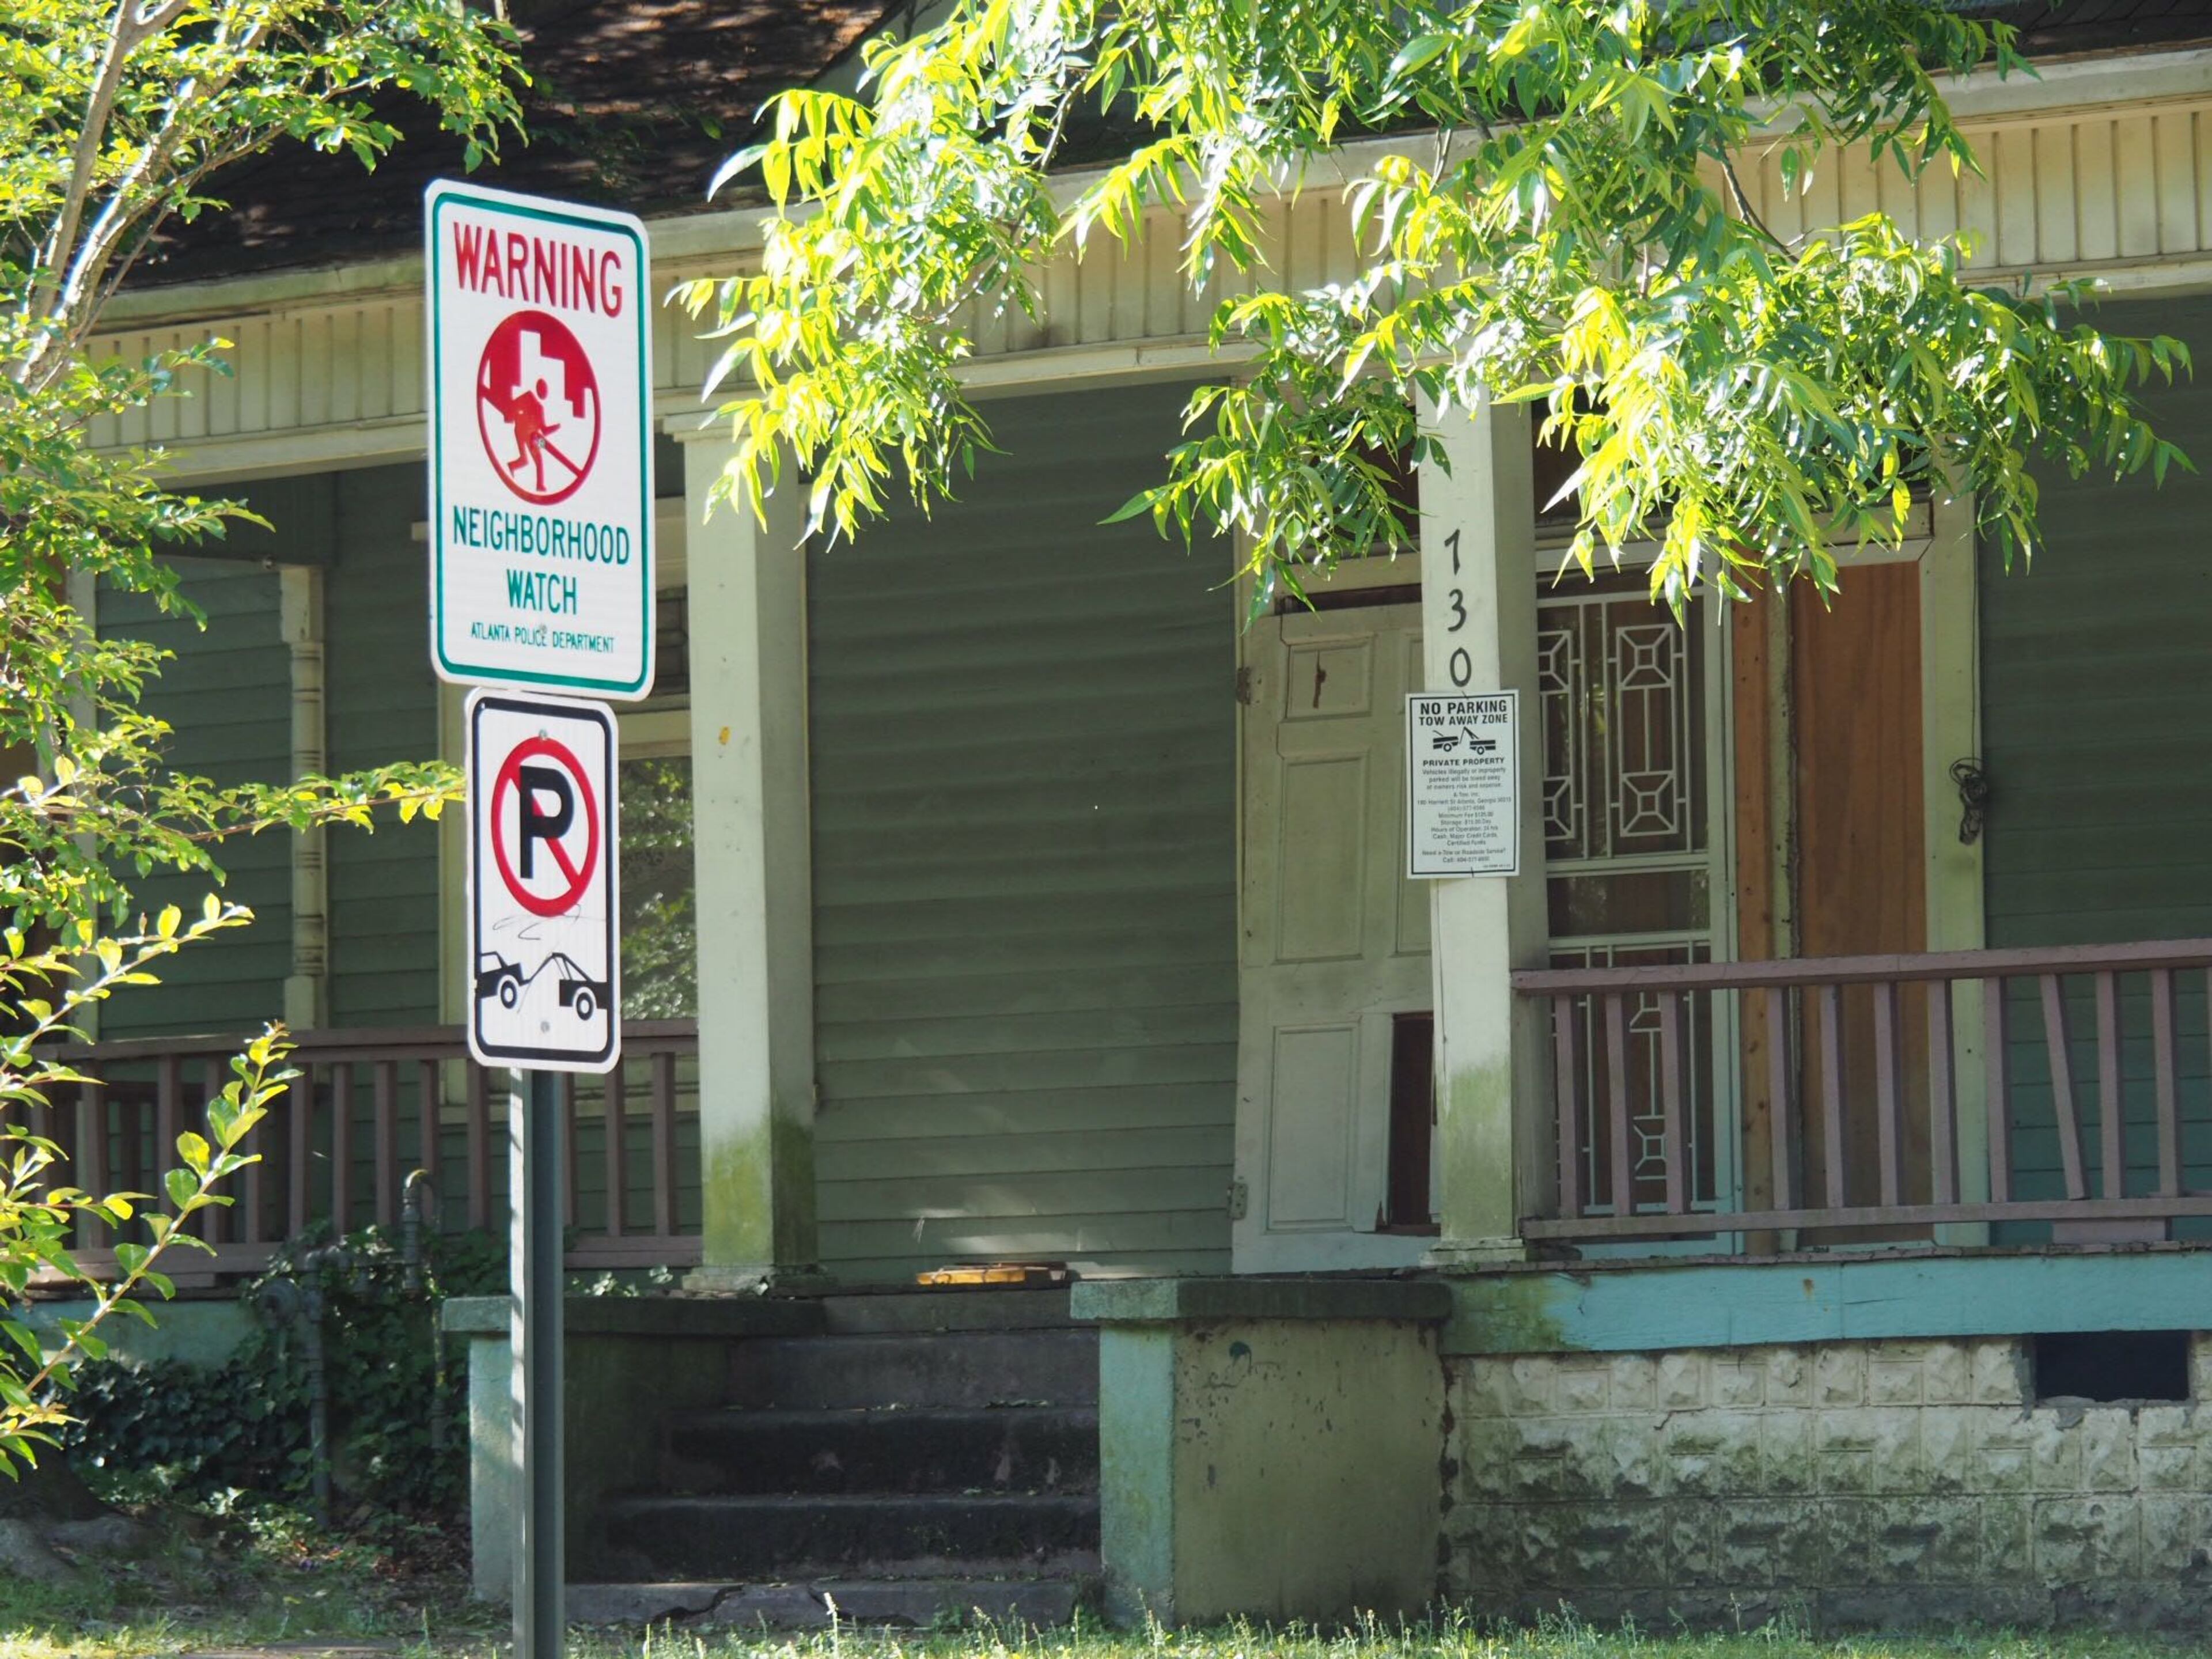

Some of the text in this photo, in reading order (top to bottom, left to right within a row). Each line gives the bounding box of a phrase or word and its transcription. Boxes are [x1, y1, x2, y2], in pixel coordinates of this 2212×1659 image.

[453, 222, 623, 317] WARNING
[453, 505, 630, 565] NEIGHBORHOOD
[506, 568, 577, 615] WATCH
[471, 622, 614, 653] ATLANTA POLICE DEPARTMENT
[1419, 714, 1508, 726] TOW AWAY ZONE
[1421, 700, 1507, 715] NO PARKING
[1463, 757, 1505, 766] PROPERTY
[520, 765, 574, 879] P
